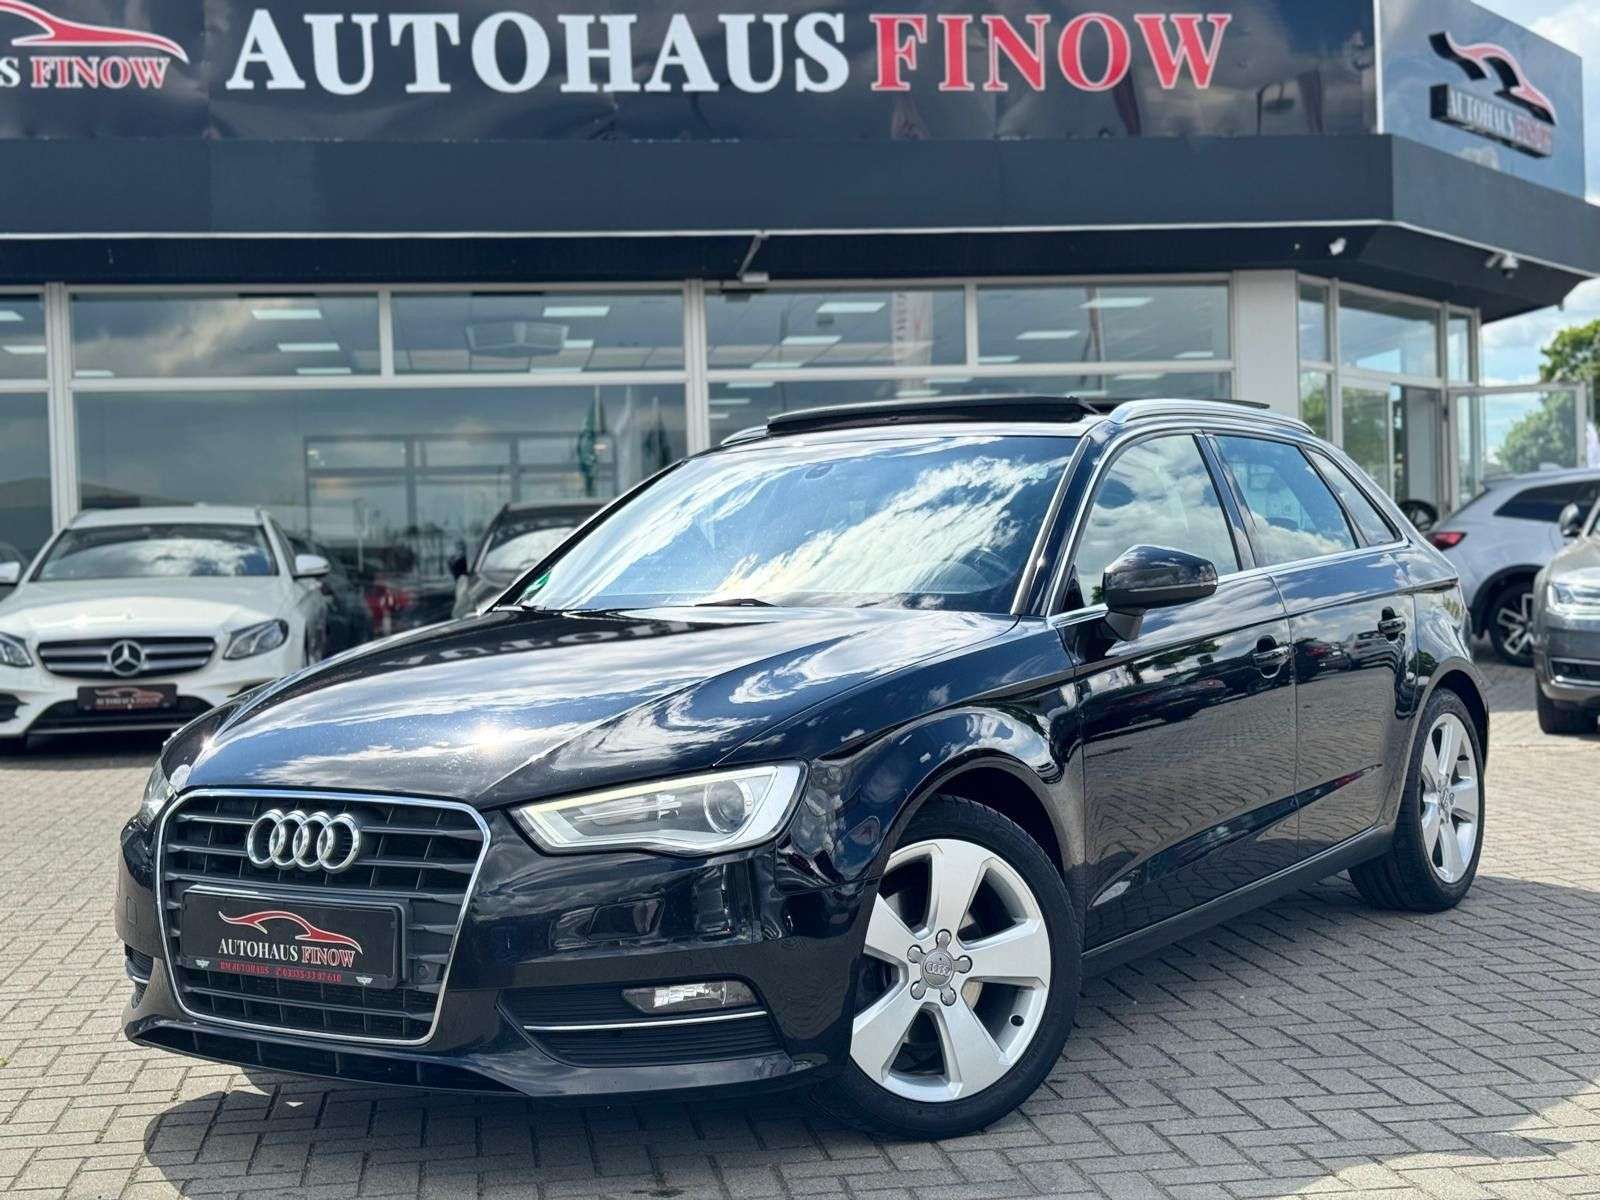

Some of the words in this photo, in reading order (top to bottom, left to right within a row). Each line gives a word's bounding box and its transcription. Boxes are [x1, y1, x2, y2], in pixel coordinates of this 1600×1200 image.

[225, 8, 848, 95] AUTOHAUS
[870, 12, 1232, 93] FINOW
[29, 55, 171, 89] FINOW
[218, 938, 298, 961] AUTOHAUS
[301, 945, 356, 968] FINOW
